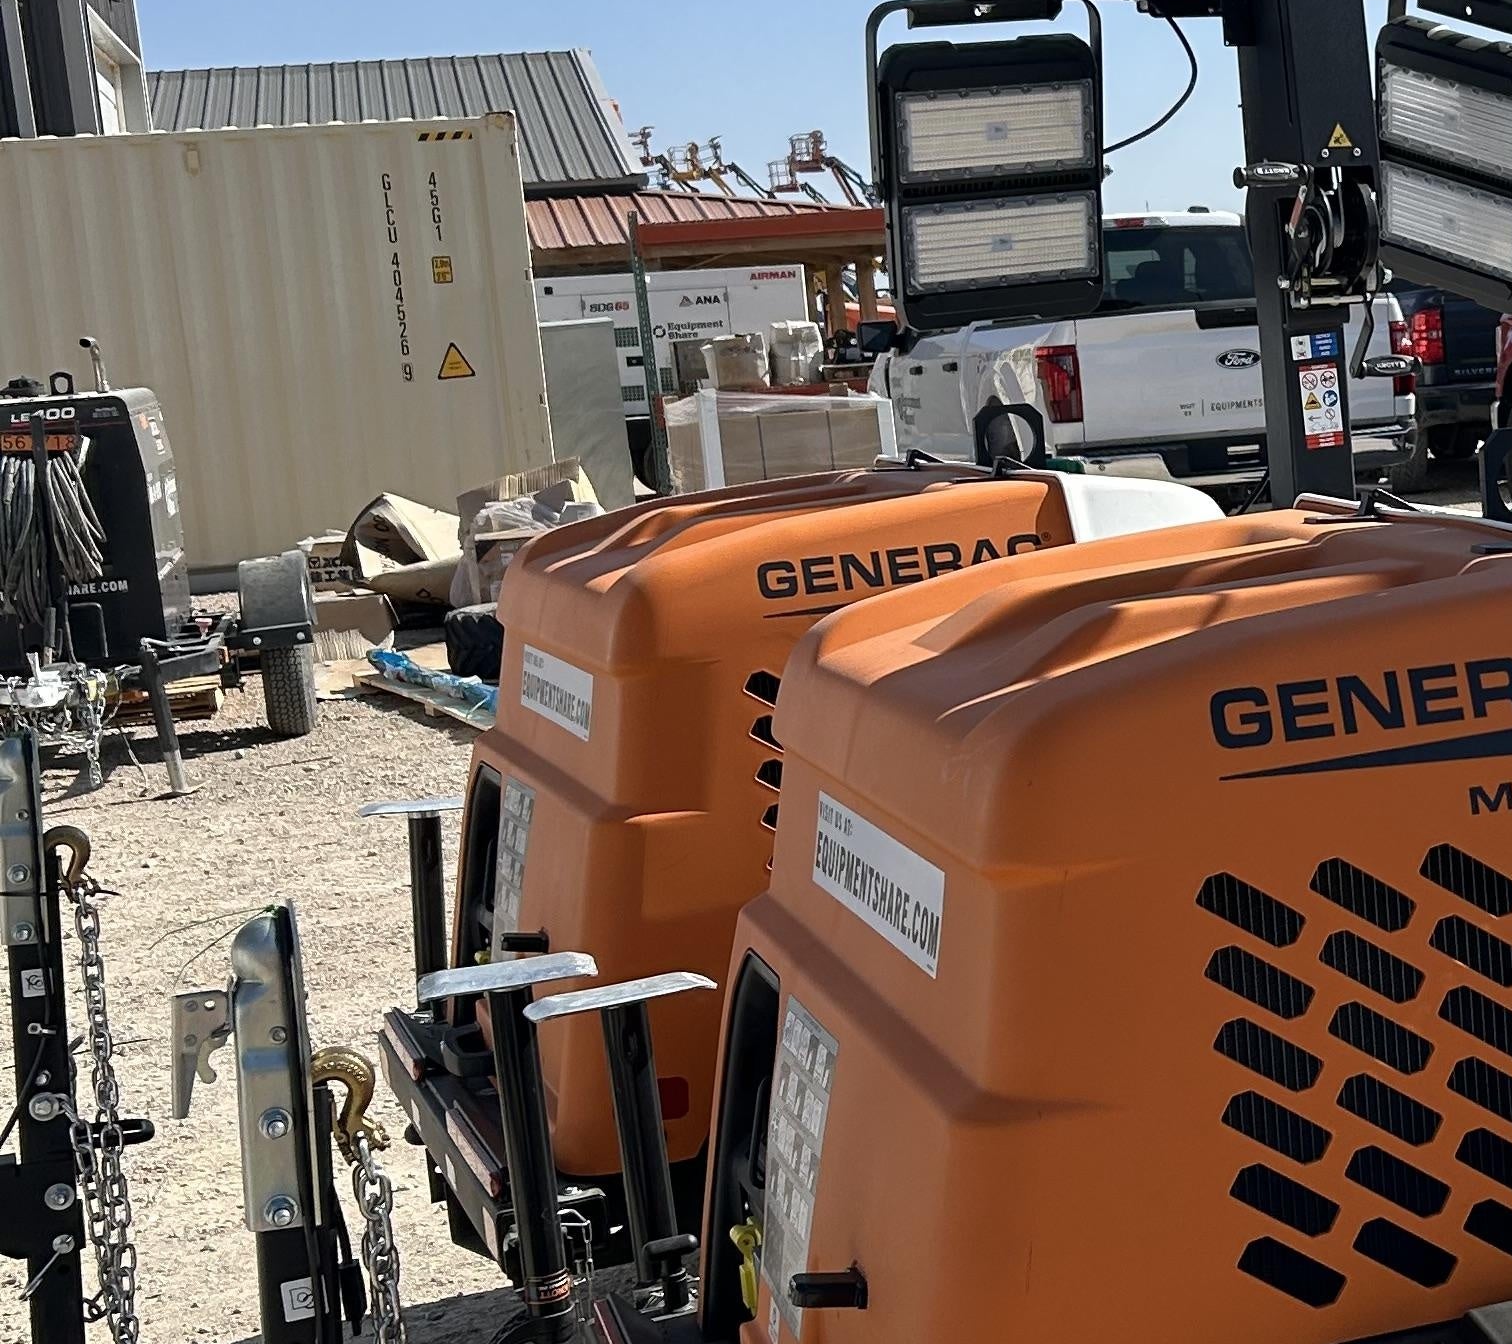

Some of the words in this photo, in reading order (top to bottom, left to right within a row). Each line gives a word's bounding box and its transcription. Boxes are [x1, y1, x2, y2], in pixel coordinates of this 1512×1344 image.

[428, 171, 442, 242] 45G1
[381, 173, 398, 244] GLCU
[391, 252, 410, 356] 404526
[403, 363, 413, 381] 9
[749, 270, 797, 281] AIRMAN
[695, 295, 721, 306] ANA
[667, 319, 724, 332] Equipment
[668, 331, 699, 340] Share
[1224, 351, 1256, 366] Ford
[1210, 398, 1264, 412] EQUIPMENTS
[756, 533, 1043, 599] GENERAC
[522, 670, 591, 731] EQUIPMENTSHARE.COM
[819, 800, 834, 825] VISIT
[834, 808, 843, 831] US
[815, 830, 940, 960] EQUIPMENTSHARE.COM
